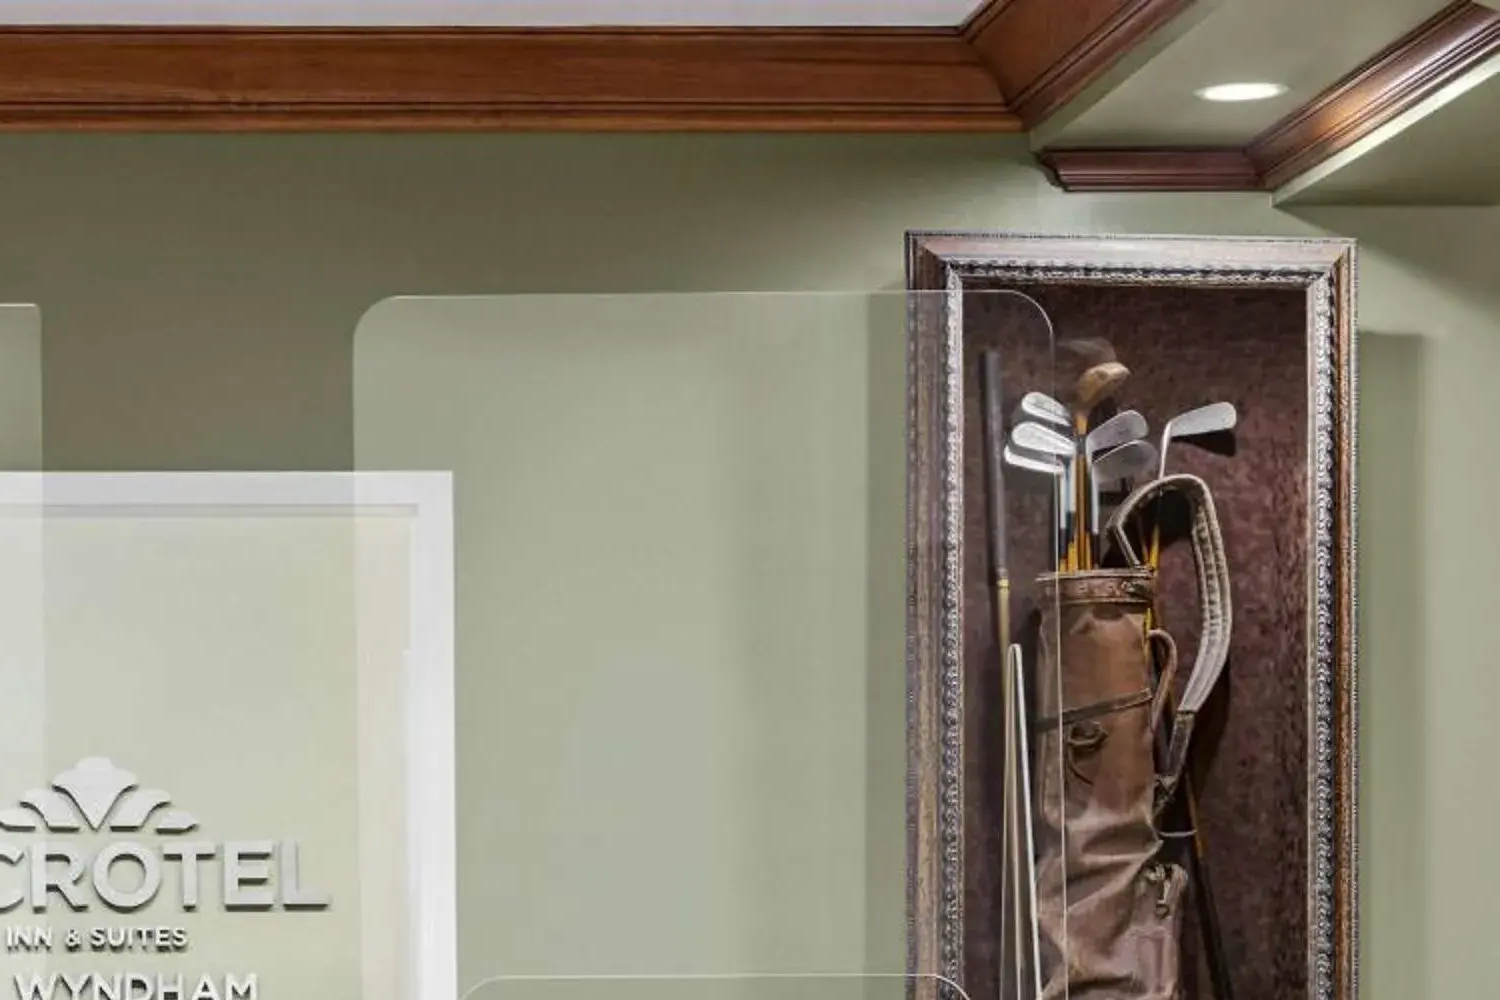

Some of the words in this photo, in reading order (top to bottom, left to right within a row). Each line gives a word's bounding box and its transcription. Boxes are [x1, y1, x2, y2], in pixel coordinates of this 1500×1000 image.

[6, 926, 52, 952] INN
[64, 928, 83, 952] &
[90, 926, 188, 952] SUITES
